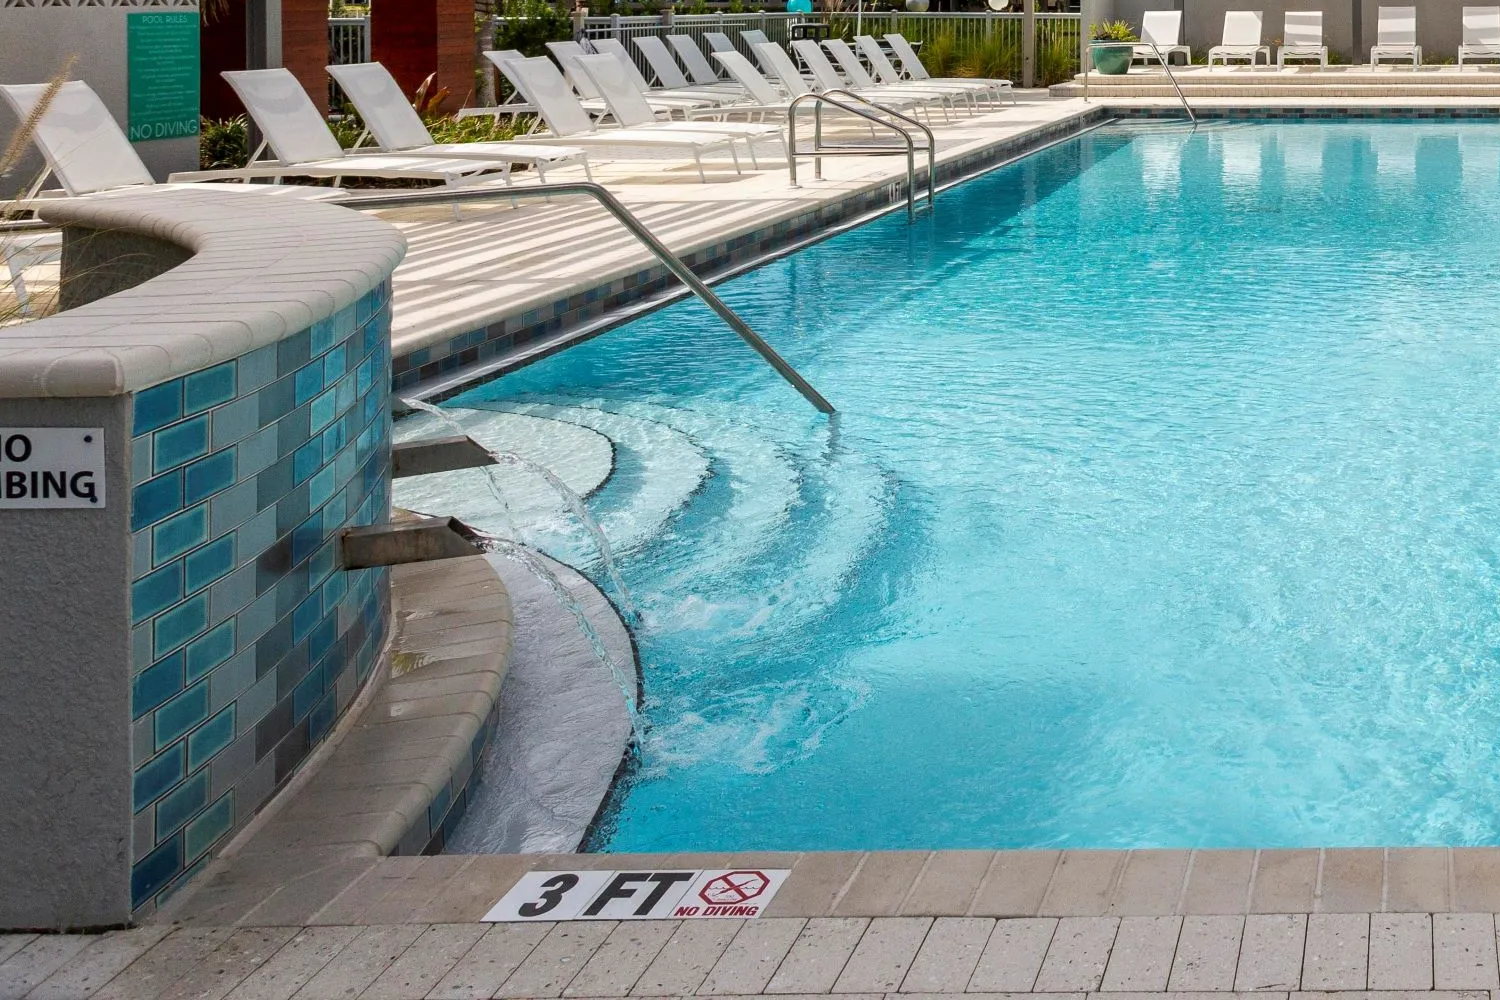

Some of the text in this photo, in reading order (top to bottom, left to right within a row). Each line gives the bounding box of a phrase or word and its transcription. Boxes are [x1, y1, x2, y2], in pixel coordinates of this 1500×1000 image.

[142, 15, 188, 24] POOL RULES
[130, 119, 198, 140] NO DIVING
[0, 433, 32, 462] O
[0, 471, 95, 499] BING
[518, 872, 696, 918] 3 FT
[673, 905, 760, 917] NO DIVING
